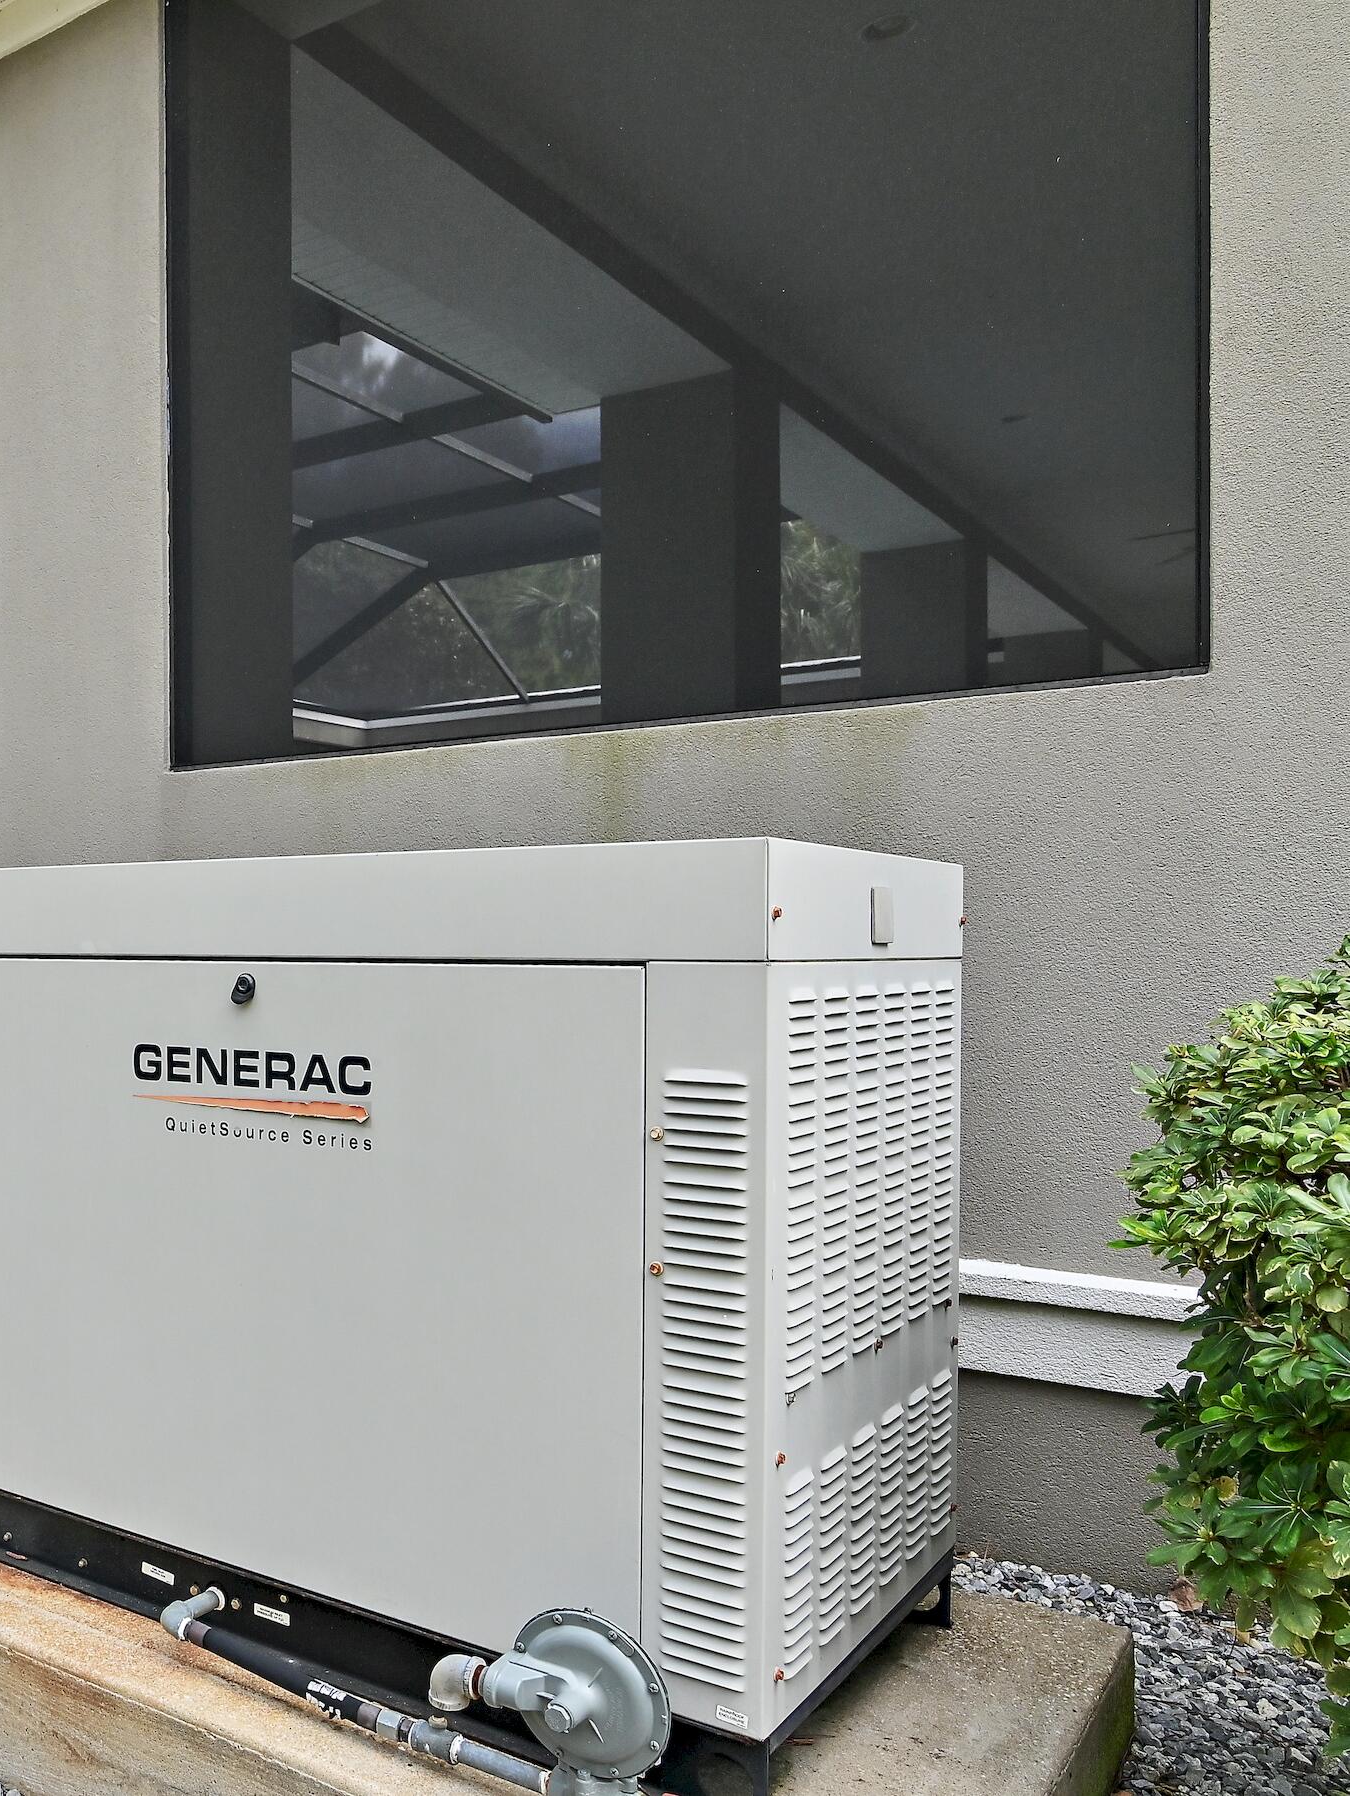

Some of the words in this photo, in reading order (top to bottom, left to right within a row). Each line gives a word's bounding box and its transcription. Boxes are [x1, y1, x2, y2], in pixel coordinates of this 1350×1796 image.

[133, 1043, 372, 1096] GENERAC
[165, 1117, 290, 1143] QuietSource
[302, 1130, 372, 1151] Series
